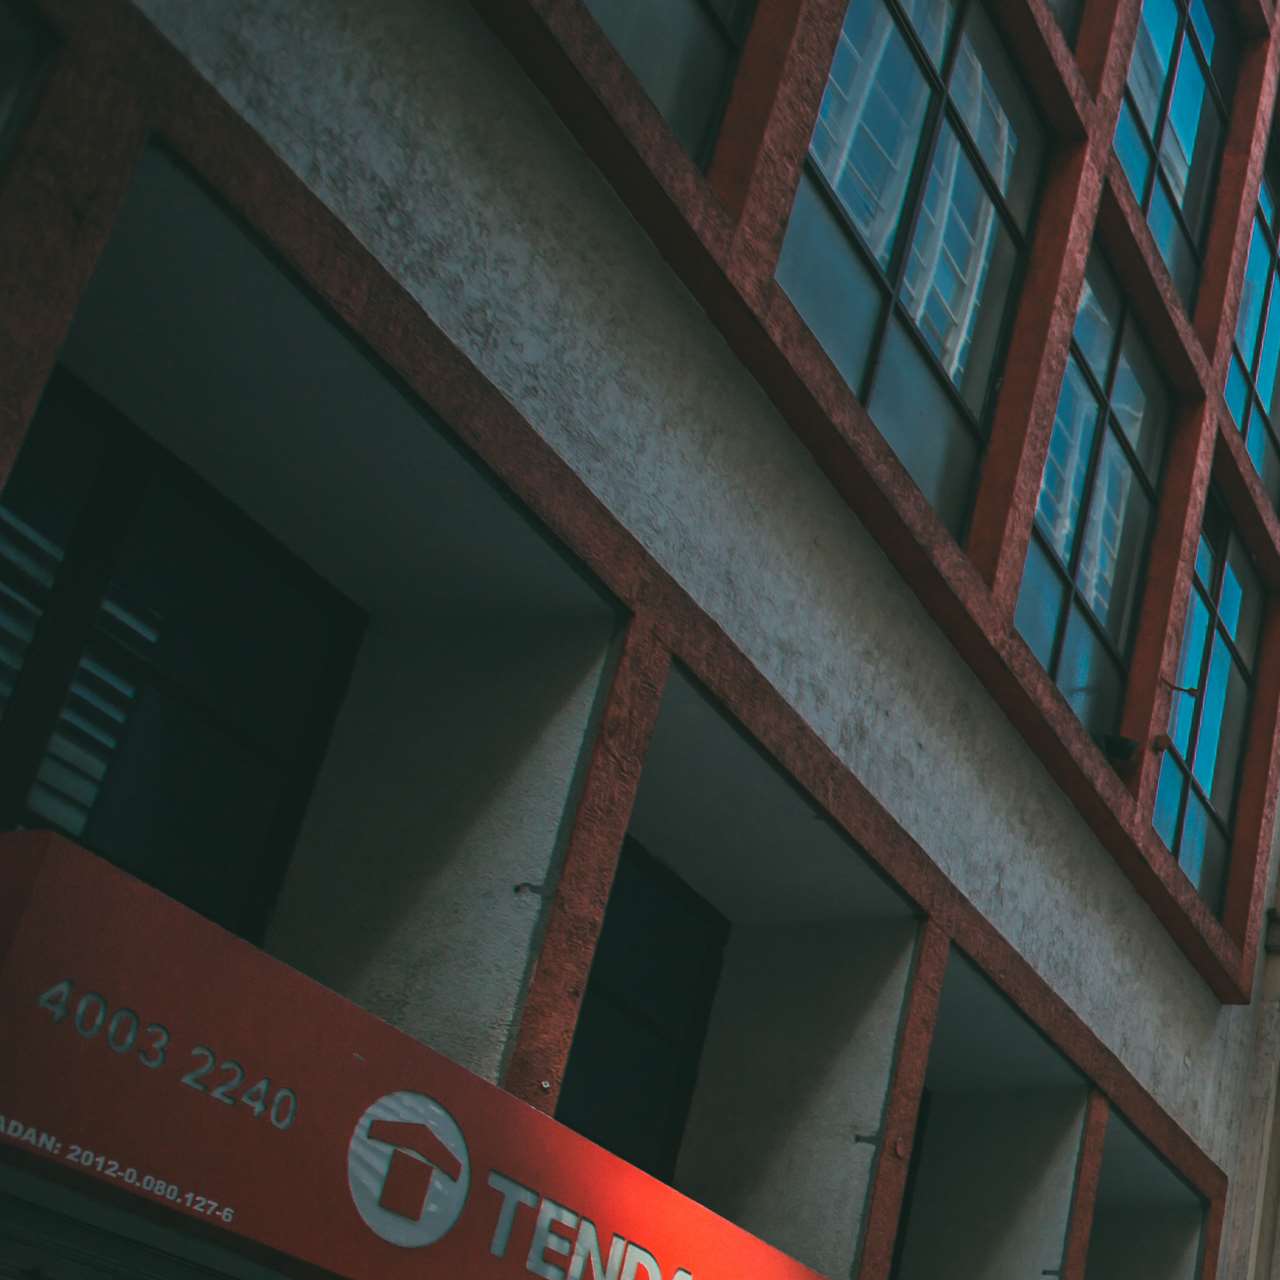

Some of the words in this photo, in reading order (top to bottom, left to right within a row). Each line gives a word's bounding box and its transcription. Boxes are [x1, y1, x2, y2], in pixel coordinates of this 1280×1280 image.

[38, 978, 171, 1070] 4003
[181, 1044, 298, 1131] 2240
[66, 1144, 236, 1223] 2012-0.080.127-6
